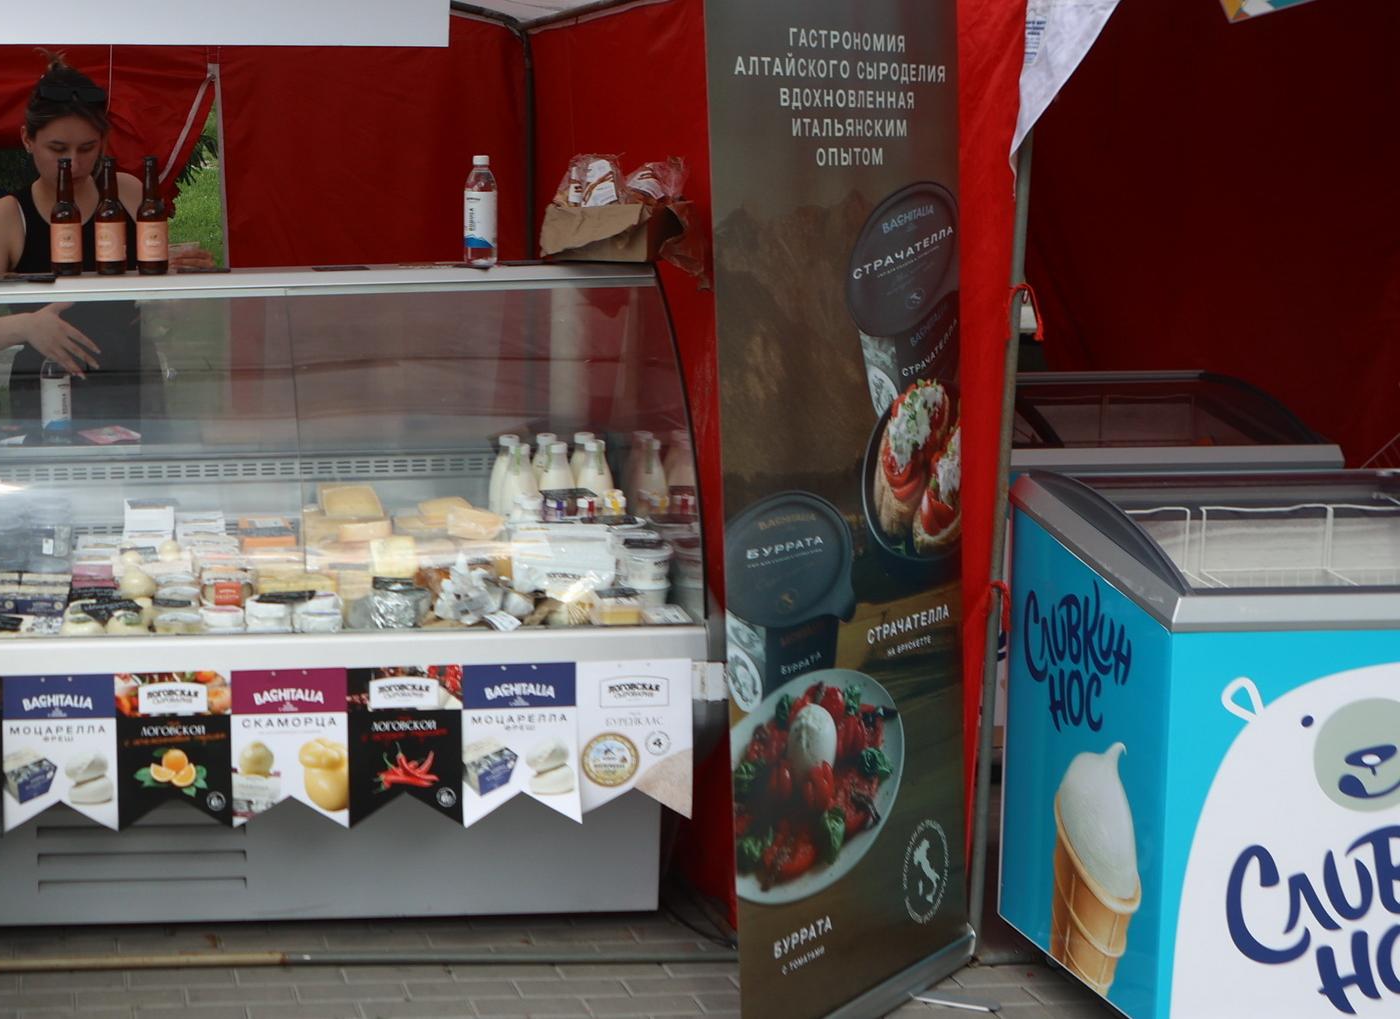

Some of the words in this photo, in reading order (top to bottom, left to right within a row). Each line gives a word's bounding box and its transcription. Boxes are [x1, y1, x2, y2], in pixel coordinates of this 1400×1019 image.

[788, 28, 905, 53] ГАСТРОНОМИЯ
[734, 53, 850, 78] АЛТАЙСКОГО
[857, 61, 946, 84] СЫРОДЕЛИЯ
[780, 88, 915, 110] ВДОХНОВЛЕННАЯ
[792, 118, 907, 137] ИТАЛЬЯНСКИМ
[816, 147, 883, 166] ОПЫТОМ
[853, 226, 953, 279] СТРАЧАТЕЛЛА
[746, 536, 824, 559] БУРРАТА
[867, 604, 950, 644] СТРАЧАТЕЛЛА
[253, 688, 325, 705] BAGHITALIA
[484, 682, 556, 701] BAGHITALIA
[1048, 669, 1103, 732] НОС
[22, 694, 93, 712] BAGHITALIA
[242, 717, 337, 729] СКАМОРЦА
[472, 713, 567, 725] МОЦАРЕЛЛА
[9, 725, 106, 735] МОЦАРЕЛЛА
[773, 915, 833, 960] БУРРАТА
